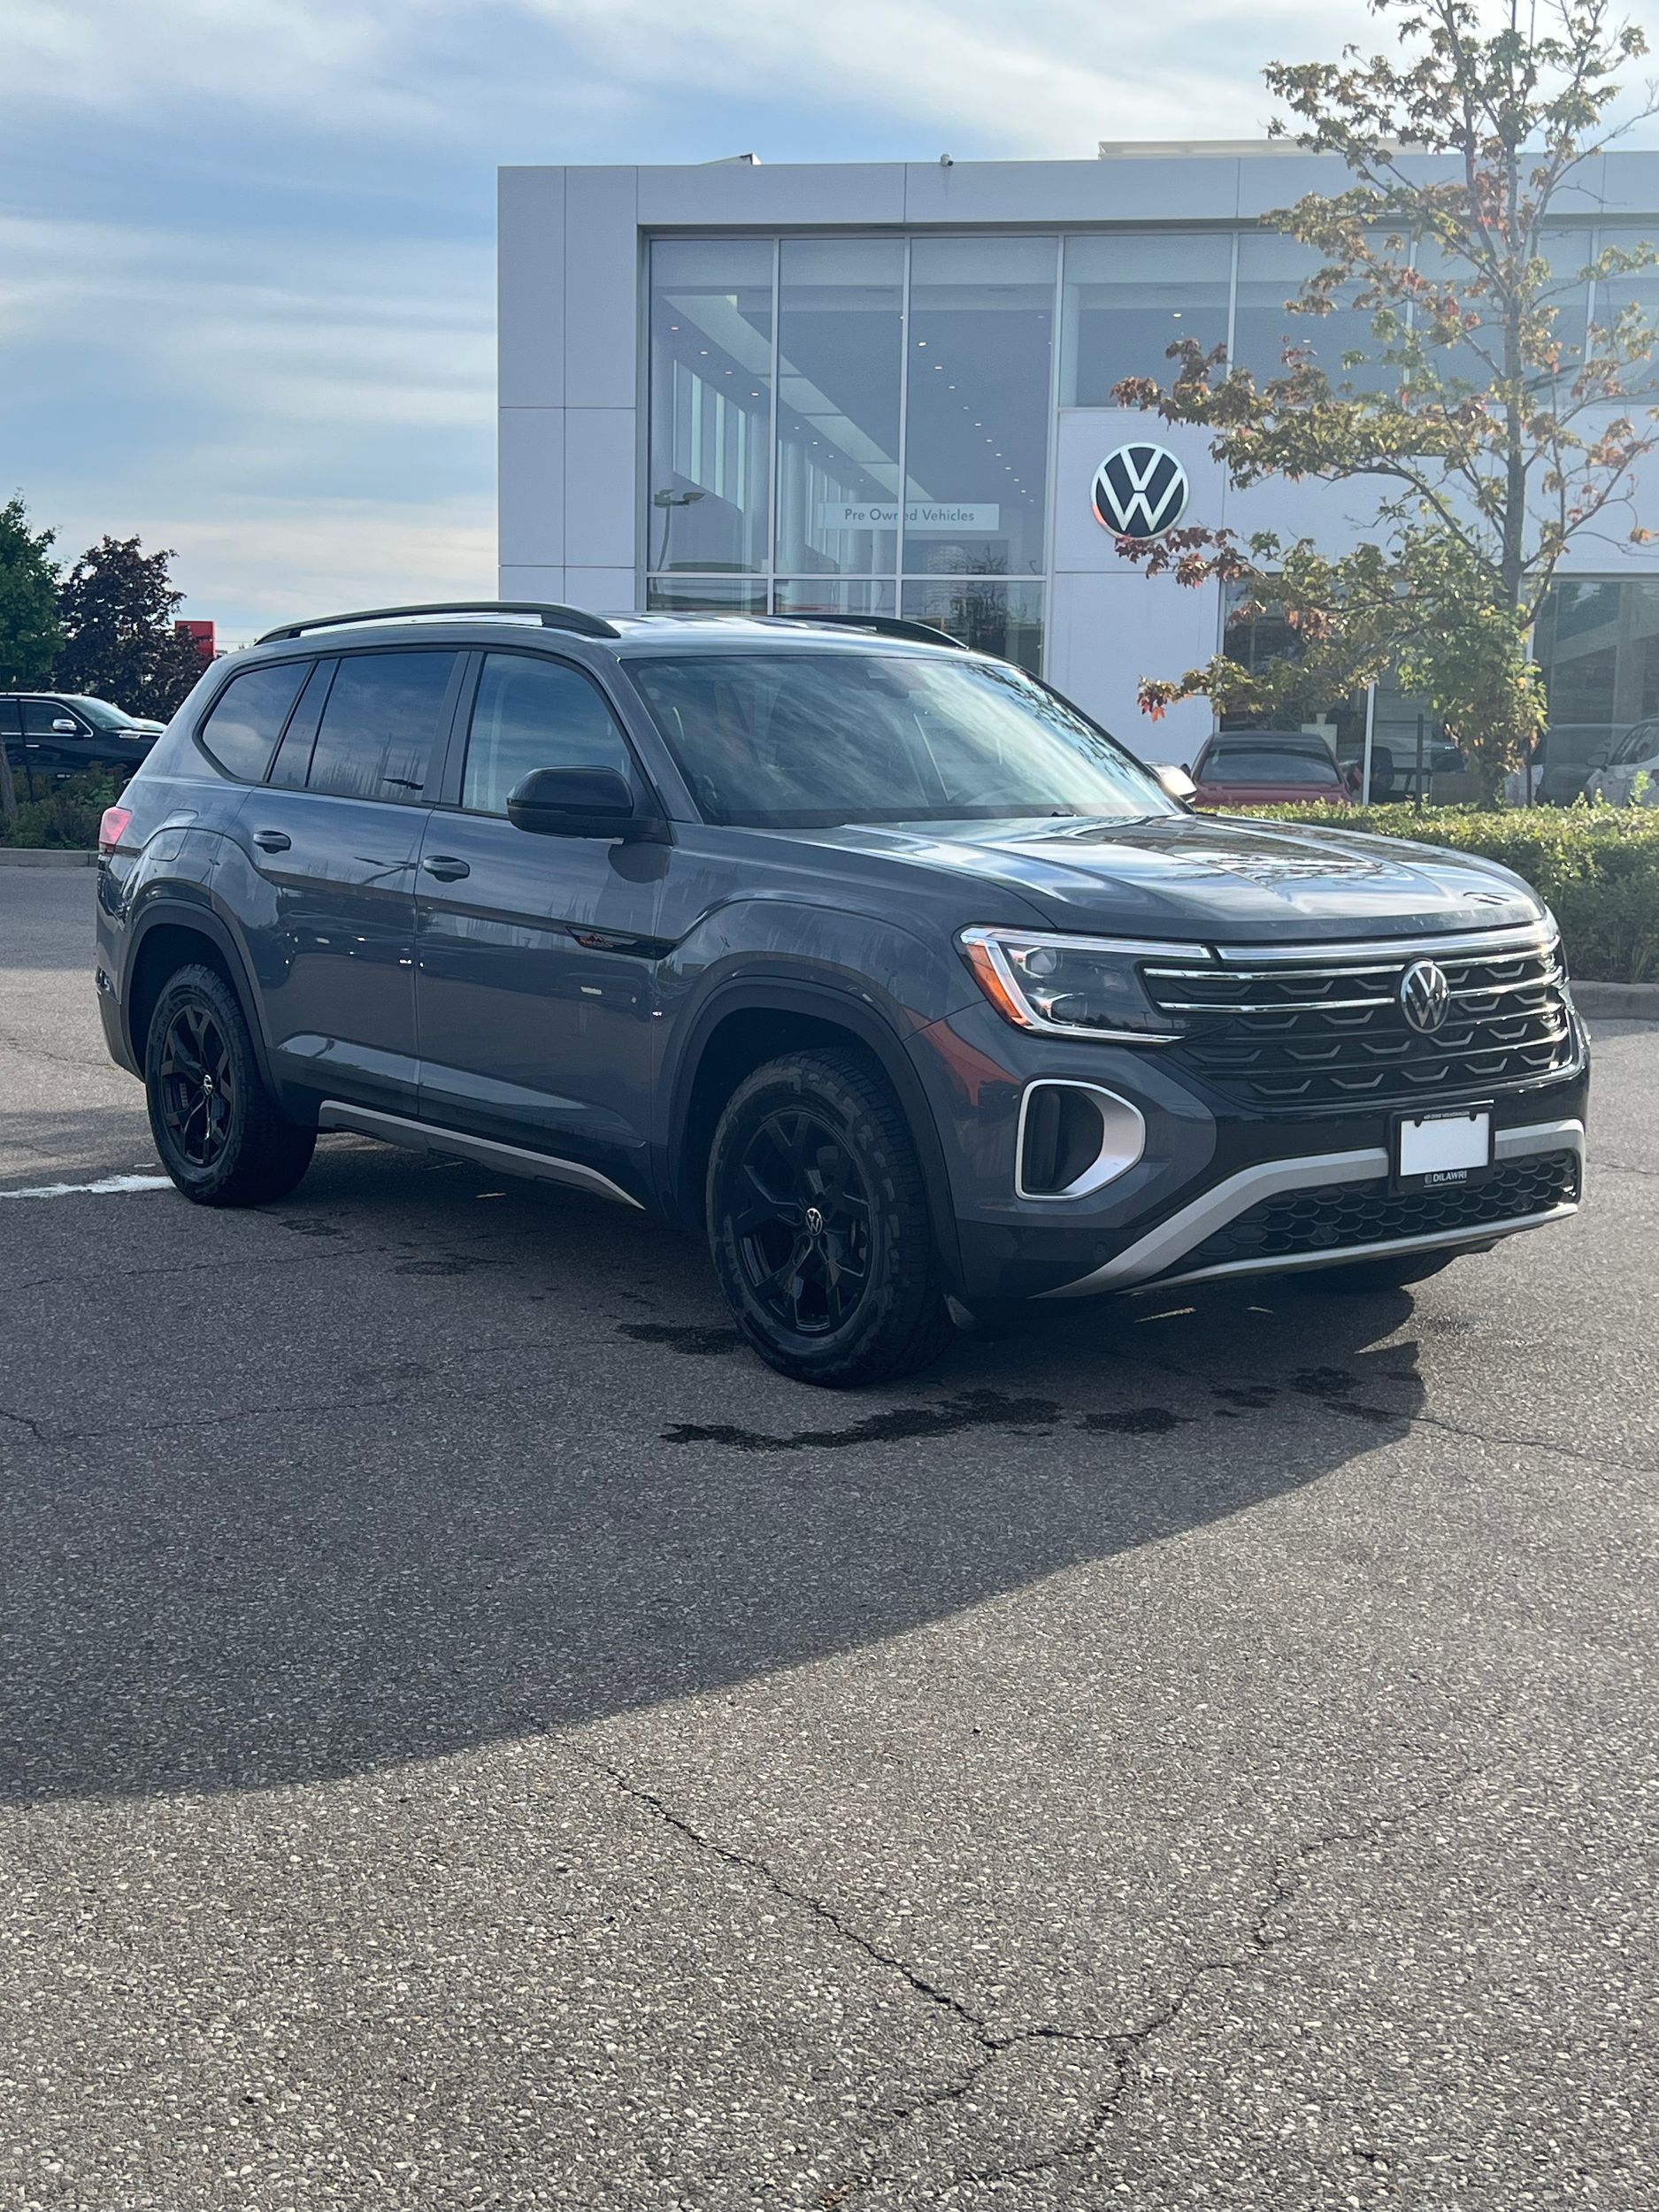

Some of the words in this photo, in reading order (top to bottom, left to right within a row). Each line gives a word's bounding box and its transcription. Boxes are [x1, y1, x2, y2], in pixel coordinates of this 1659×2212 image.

[1093, 444, 1187, 538] VW
[844, 508, 865, 521] Pre
[922, 508, 975, 521] Vehicles
[1402, 961, 1448, 1031] VW
[1432, 1170, 1468, 1182] DILAWRI
